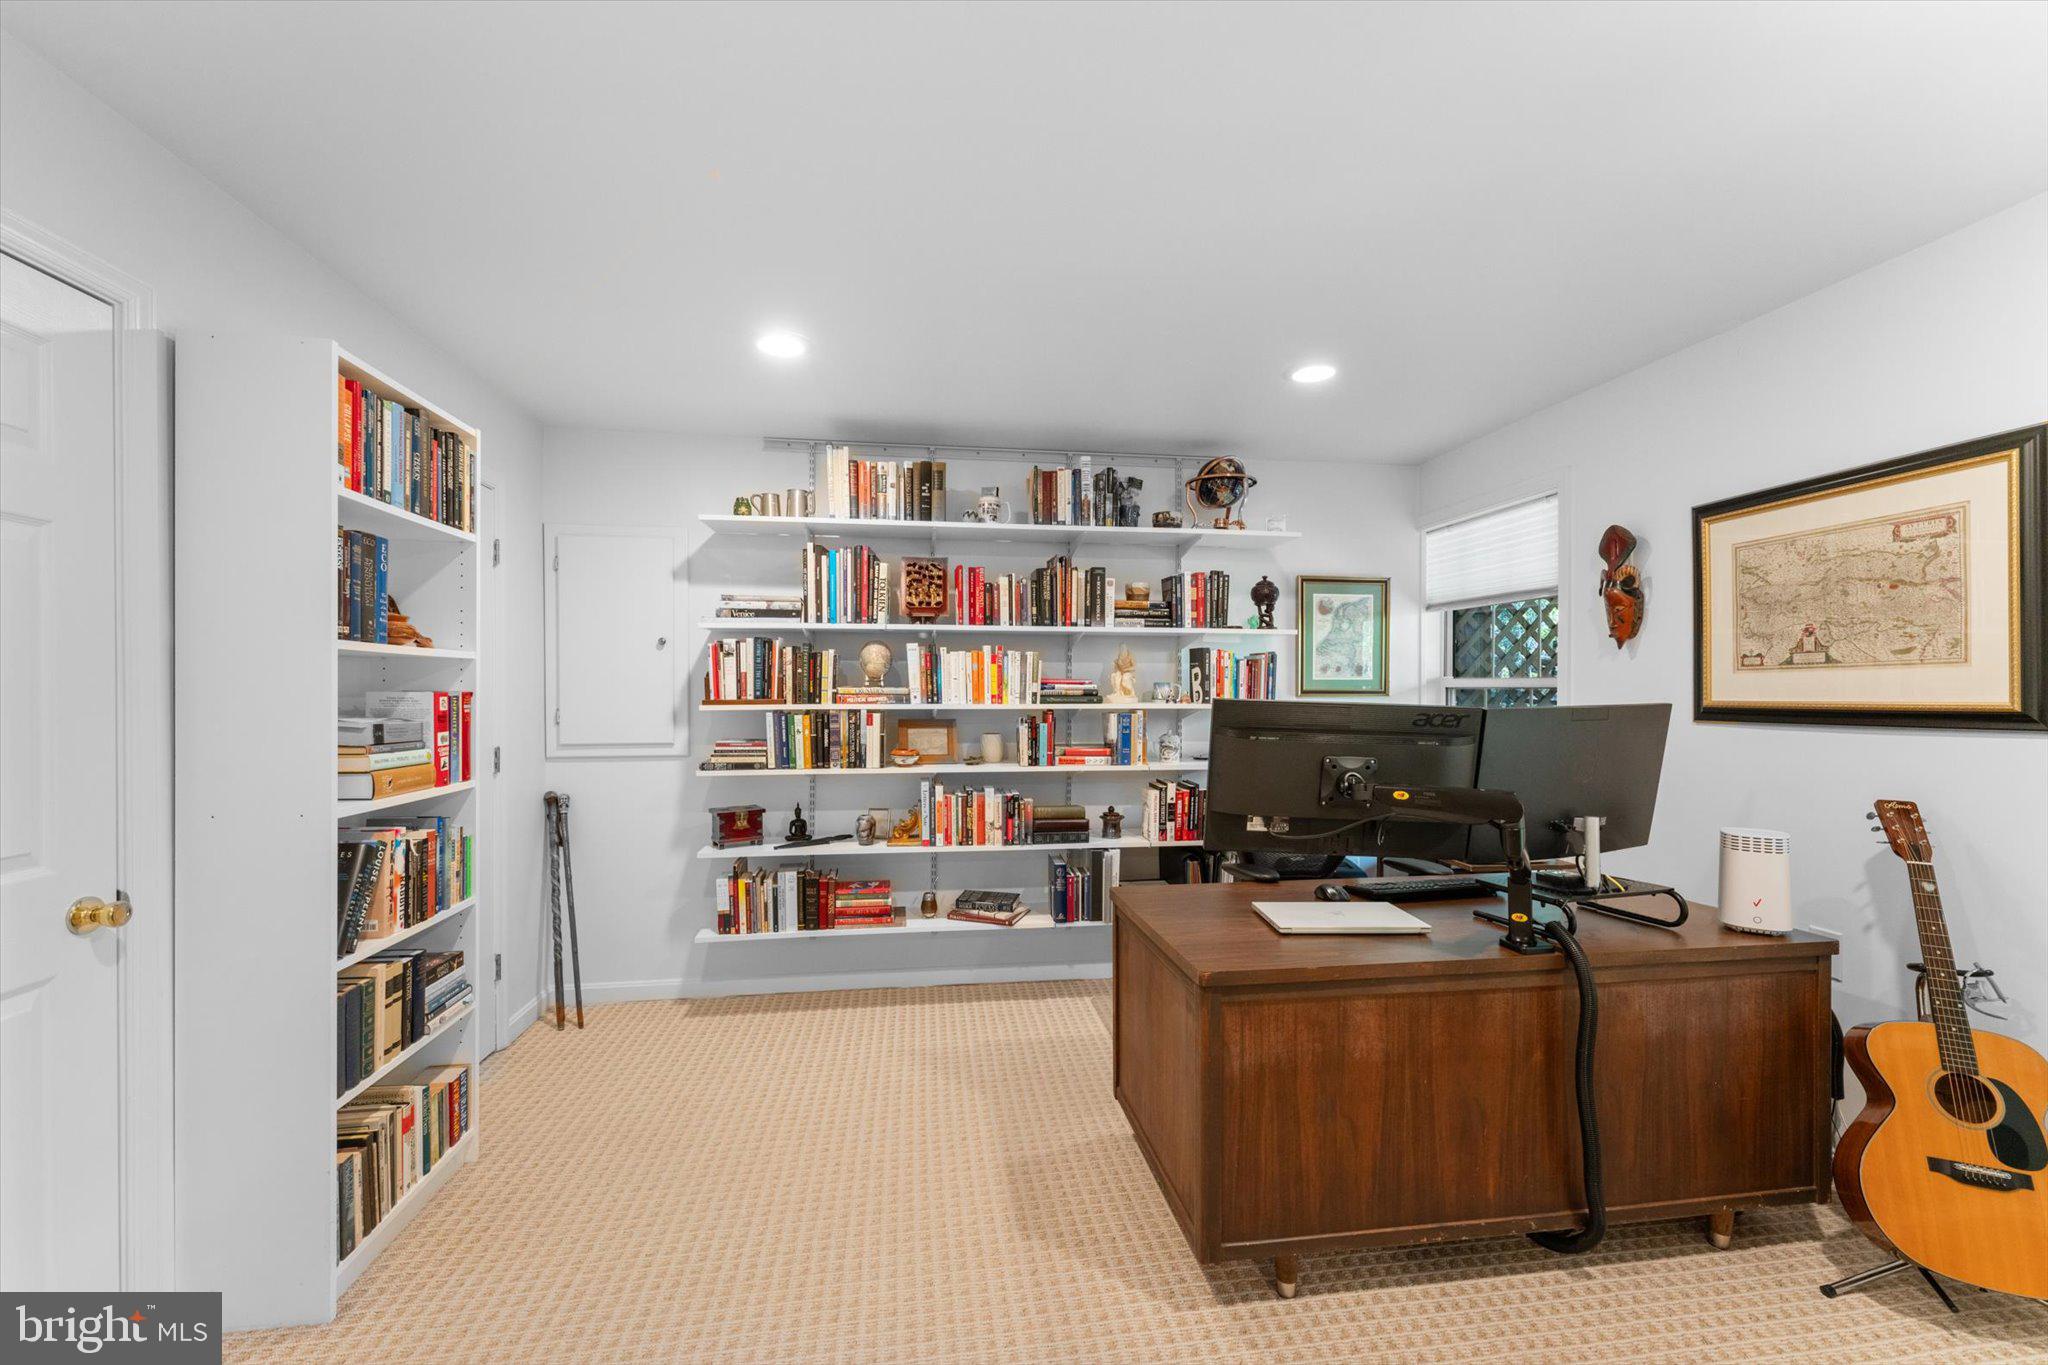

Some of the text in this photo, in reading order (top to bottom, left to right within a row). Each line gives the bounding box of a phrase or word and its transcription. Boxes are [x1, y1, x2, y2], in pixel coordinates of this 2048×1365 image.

[343, 403, 352, 442] COLLAPSE
[380, 544, 388, 573] ECO
[363, 557, 371, 607] PENDULUM
[879, 578, 887, 613] TOLKIEN
[731, 608, 755, 618] Venice
[1411, 712, 1472, 729] acer
[370, 845, 386, 883] LOUISE
[356, 896, 372, 933] PENNY
